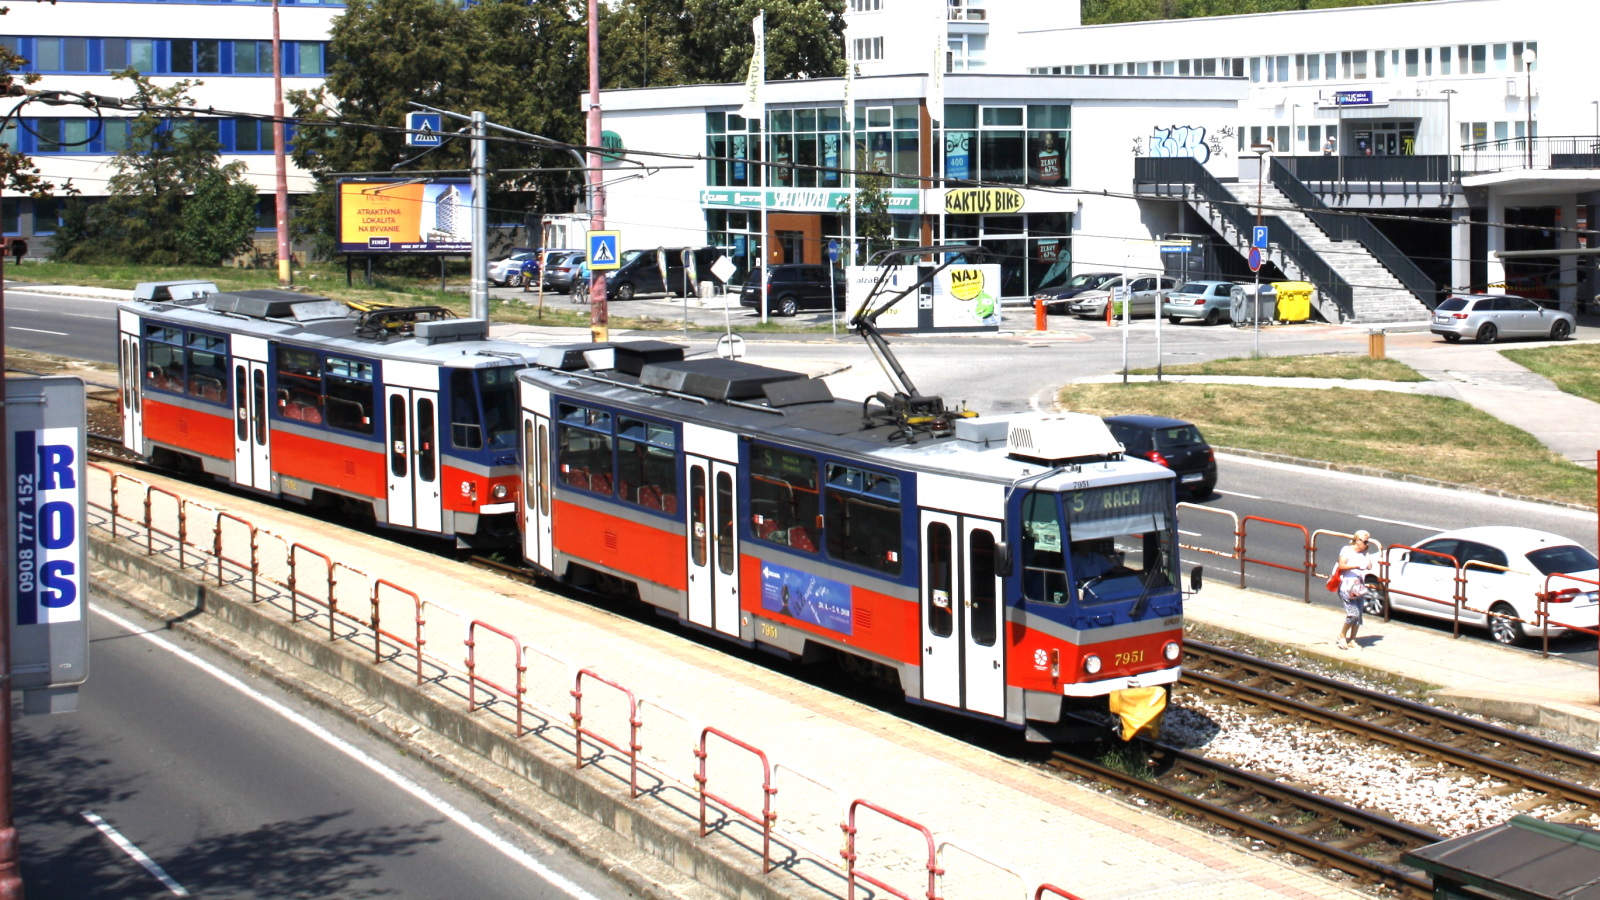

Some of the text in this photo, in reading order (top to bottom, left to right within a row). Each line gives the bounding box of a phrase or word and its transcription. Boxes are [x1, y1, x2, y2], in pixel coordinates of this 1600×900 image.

[950, 158, 964, 166] 400
[1044, 165, 1058, 173] 67%
[945, 189, 1020, 213] KAKTUS BIKE
[1257, 229, 1264, 241] P
[951, 269, 978, 283] NAJ
[1073, 481, 1090, 489] 7951
[1073, 493, 1085, 512] 5
[18, 473, 34, 593] 0908 777 152
[37, 444, 76, 608] ROS
[761, 623, 778, 639] 7951
[1115, 650, 1144, 666] 7951
